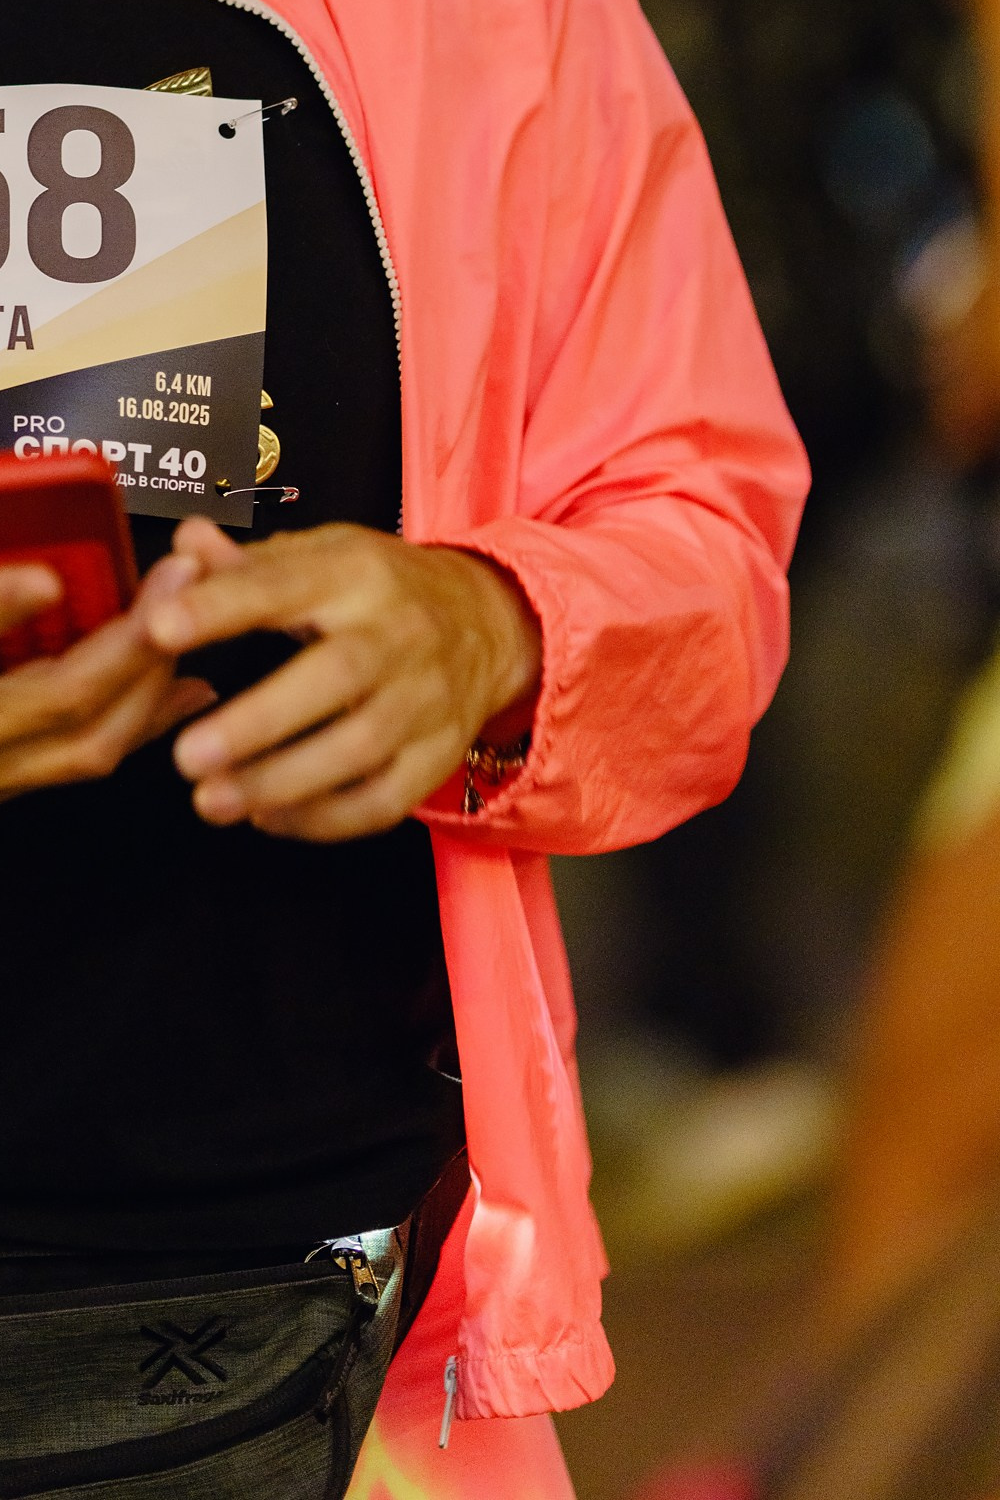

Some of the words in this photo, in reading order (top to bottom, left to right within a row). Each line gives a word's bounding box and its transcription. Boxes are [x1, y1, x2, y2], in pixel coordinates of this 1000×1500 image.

[155, 371, 183, 395] 6,4
[186, 374, 212, 397] КМ
[117, 396, 211, 426] 16.08.2025
[13, 415, 66, 434] PRO
[158, 447, 207, 479] 40
[138, 475, 148, 487] В
[149, 477, 205, 495] СПОРТЕ!
